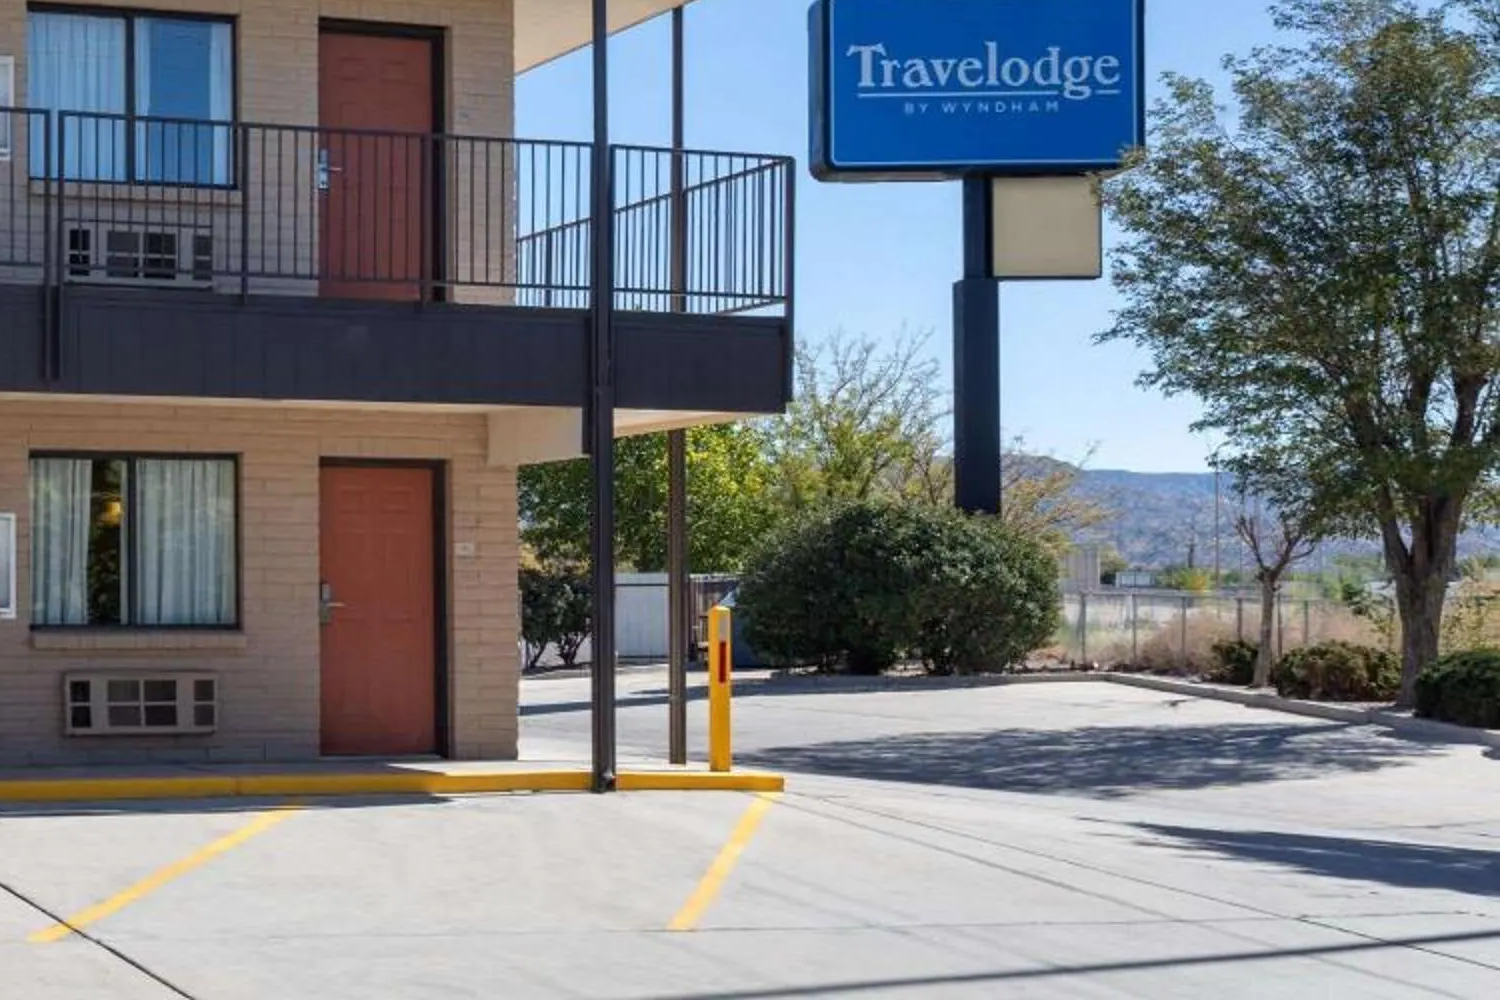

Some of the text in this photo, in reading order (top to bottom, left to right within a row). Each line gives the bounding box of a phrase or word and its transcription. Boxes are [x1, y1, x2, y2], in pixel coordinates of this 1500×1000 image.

[846, 41, 1120, 100] Travelodge
[903, 100, 1060, 115] BY WYNDHAM
